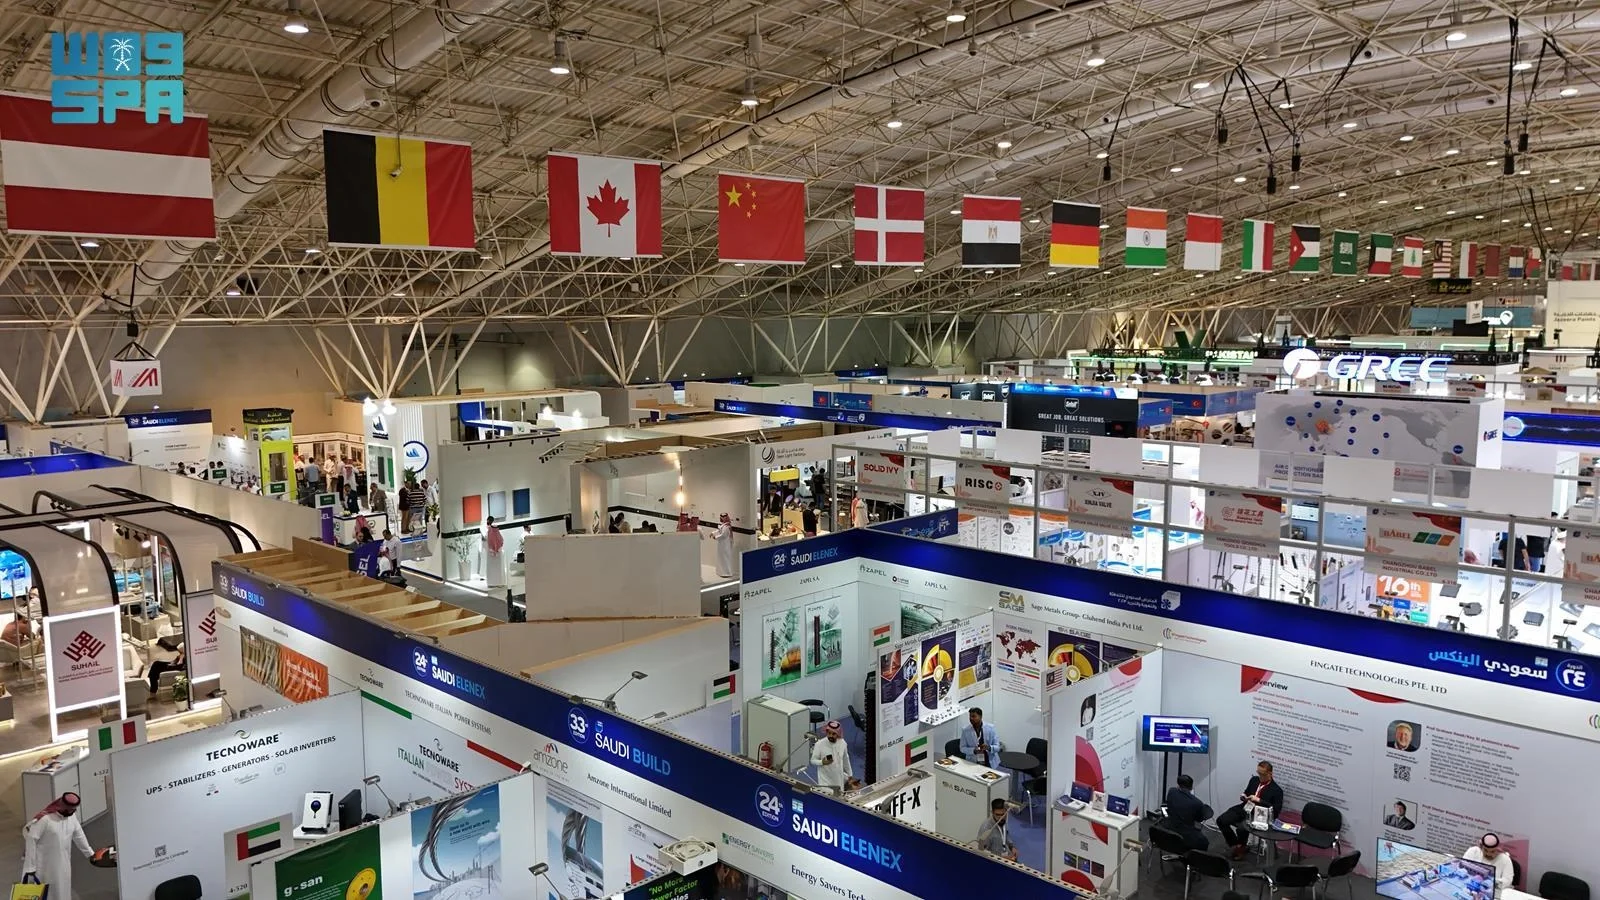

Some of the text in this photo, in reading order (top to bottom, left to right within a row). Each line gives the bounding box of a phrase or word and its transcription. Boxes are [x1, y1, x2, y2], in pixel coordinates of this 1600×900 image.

[1327, 355, 1453, 382] GREE
[863, 463, 899, 475] SOLID IVY
[791, 547, 838, 566] SAUDI ELENEX
[800, 577, 811, 585] ZAPEL
[866, 566, 887, 576] ZAPEL
[1382, 566, 1414, 575] INDUSTRIAL
[231, 585, 265, 606] SAUDI BUILD
[751, 588, 772, 597] ZAPEL
[999, 603, 1025, 613] SAGE
[1031, 603, 1043, 611] Sage
[1107, 618, 1121, 627] India
[415, 652, 428, 667] 24
[1428, 650, 1548, 680] سعودي الينكس
[360, 673, 384, 689] TECNOWARE
[432, 665, 486, 699] SAUDI ELENEX
[1310, 660, 1447, 694] FINGATE TECHNOLOGIES PTE. LTD
[1562, 669, 1587, 688] ٢٤
[454, 712, 471, 726] POWER
[471, 719, 492, 735] SYSTEMS
[570, 713, 586, 733] 33
[206, 733, 280, 762] TECNOWARE
[595, 733, 671, 776] SAUDI BUILD
[146, 784, 163, 796] UPS
[168, 769, 216, 789] STABILIZERS
[221, 754, 270, 773] GENERATORS
[275, 745, 299, 758] SOLAR
[299, 735, 336, 751] INVERTERS
[397, 747, 425, 770] ITALIAN
[419, 745, 460, 773] TECNOWARE
[533, 748, 568, 774] amzone
[587, 773, 609, 790] Amzone
[610, 783, 647, 807] International
[648, 801, 672, 818] Limited
[954, 784, 976, 798] SAGE
[761, 810, 779, 822] EDITION
[729, 835, 751, 850] ENERGY
[792, 813, 903, 873] SAUDI ELENEX
[674, 880, 698, 896] Factor
[791, 864, 818, 885] Energy
[819, 877, 846, 897] Savers
